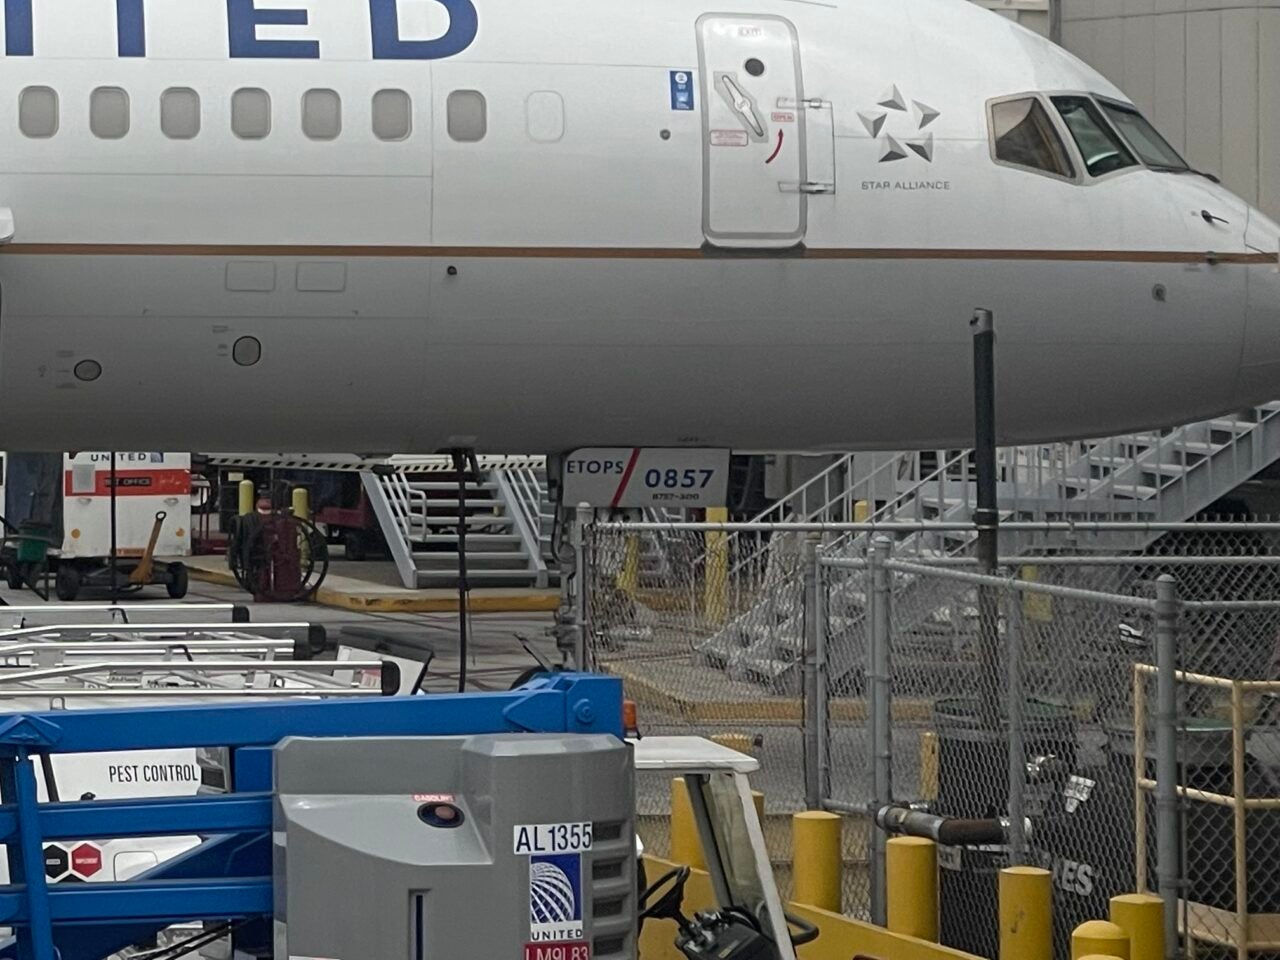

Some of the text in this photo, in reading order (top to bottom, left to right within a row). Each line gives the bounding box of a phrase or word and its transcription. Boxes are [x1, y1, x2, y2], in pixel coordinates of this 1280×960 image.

[861, 181, 951, 190] STAR ALLIANCE
[90, 453, 147, 462] UNTED
[567, 460, 624, 474] ETOPS
[645, 468, 715, 488] 0857
[109, 764, 199, 783] PEST CONTROL
[531, 929, 583, 941] UNITED
